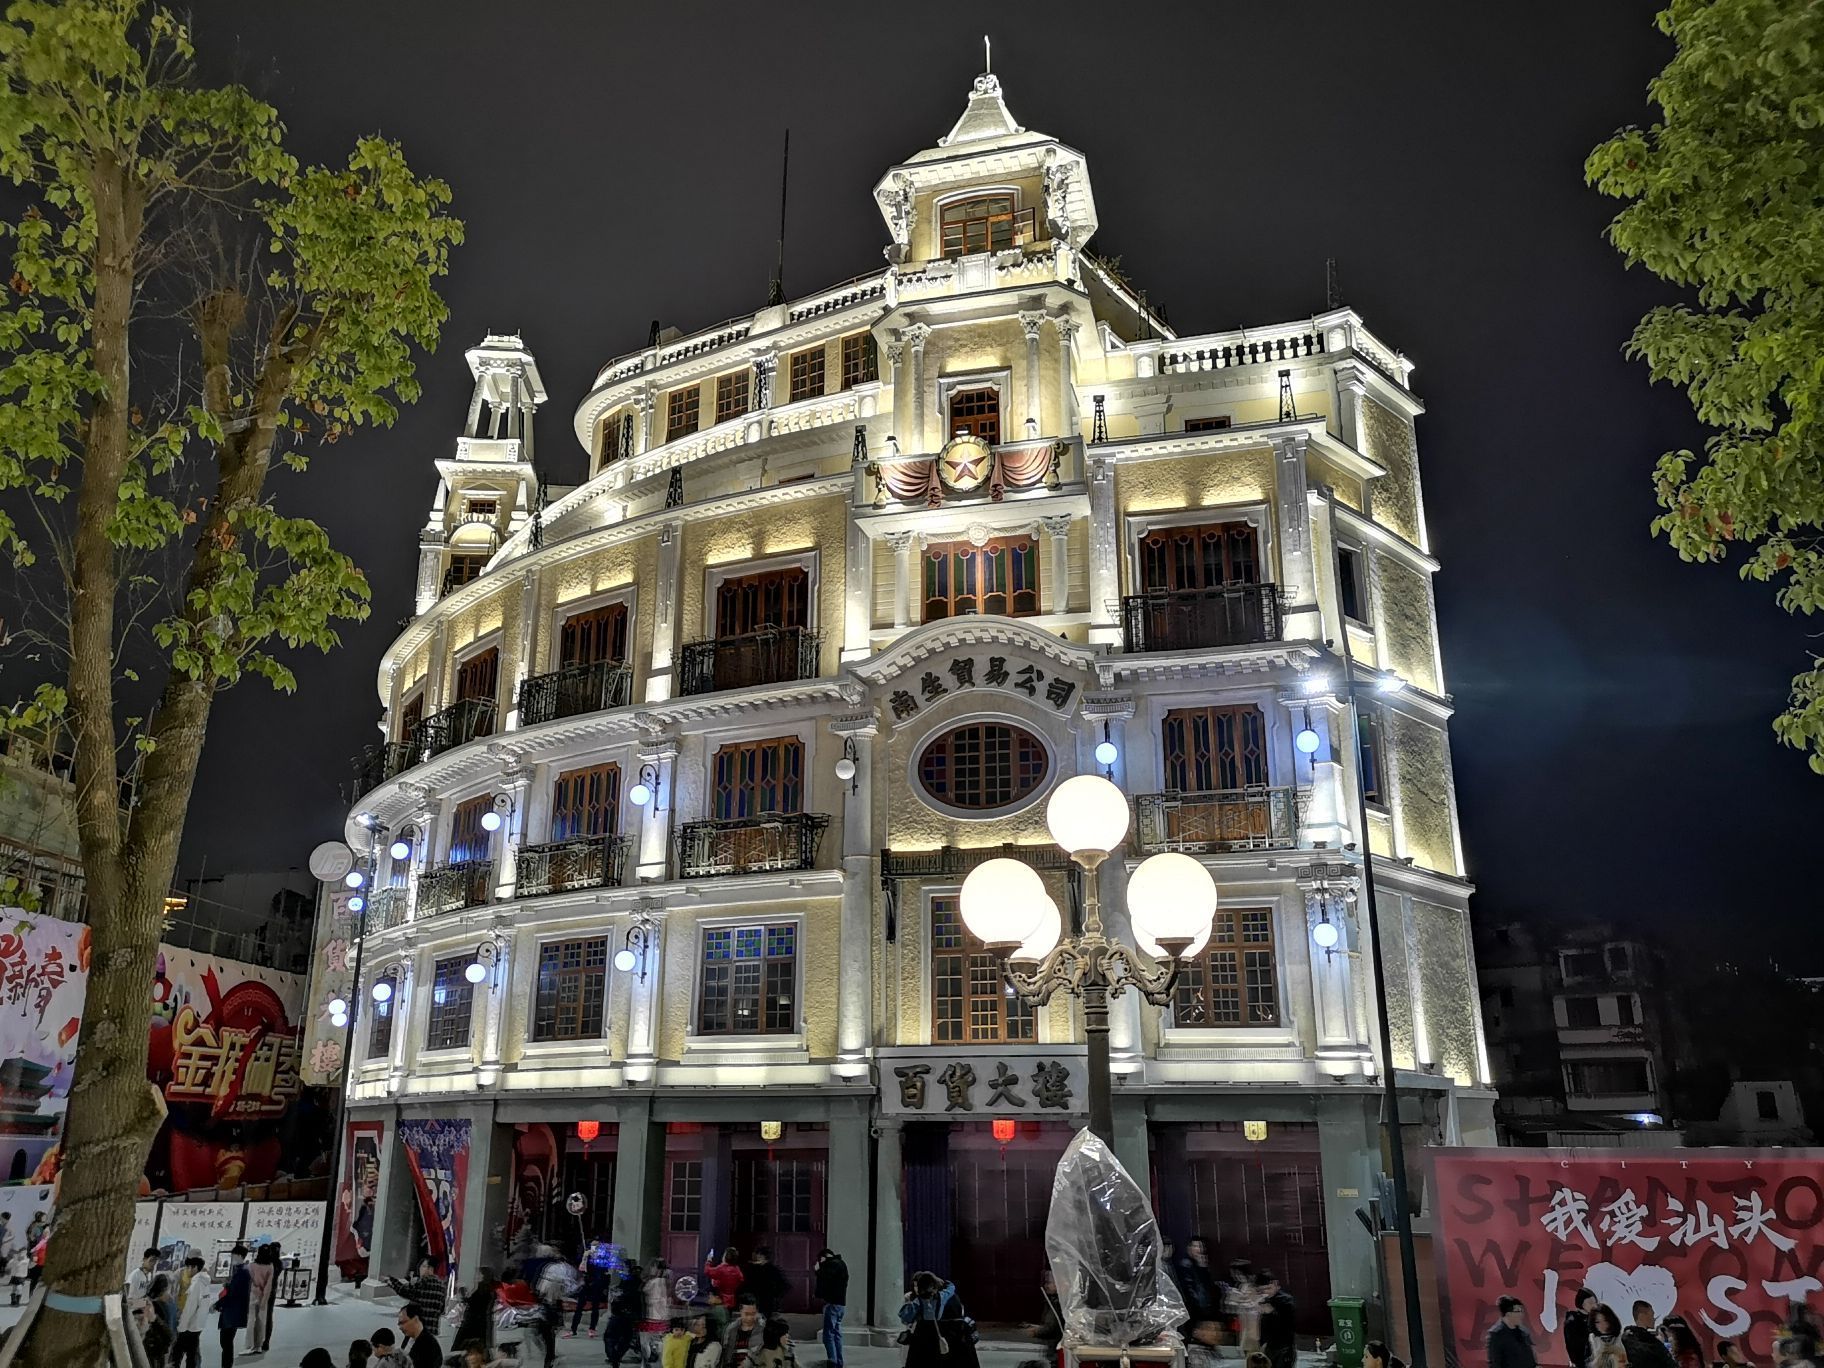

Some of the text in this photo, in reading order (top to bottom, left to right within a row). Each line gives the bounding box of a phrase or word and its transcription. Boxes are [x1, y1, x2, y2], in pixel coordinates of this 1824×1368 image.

[889, 656, 1076, 720] 南生貿易公司
[894, 1061, 1073, 1112] 百貨大樓
[1540, 1188, 1798, 1253] 我爱汕头
